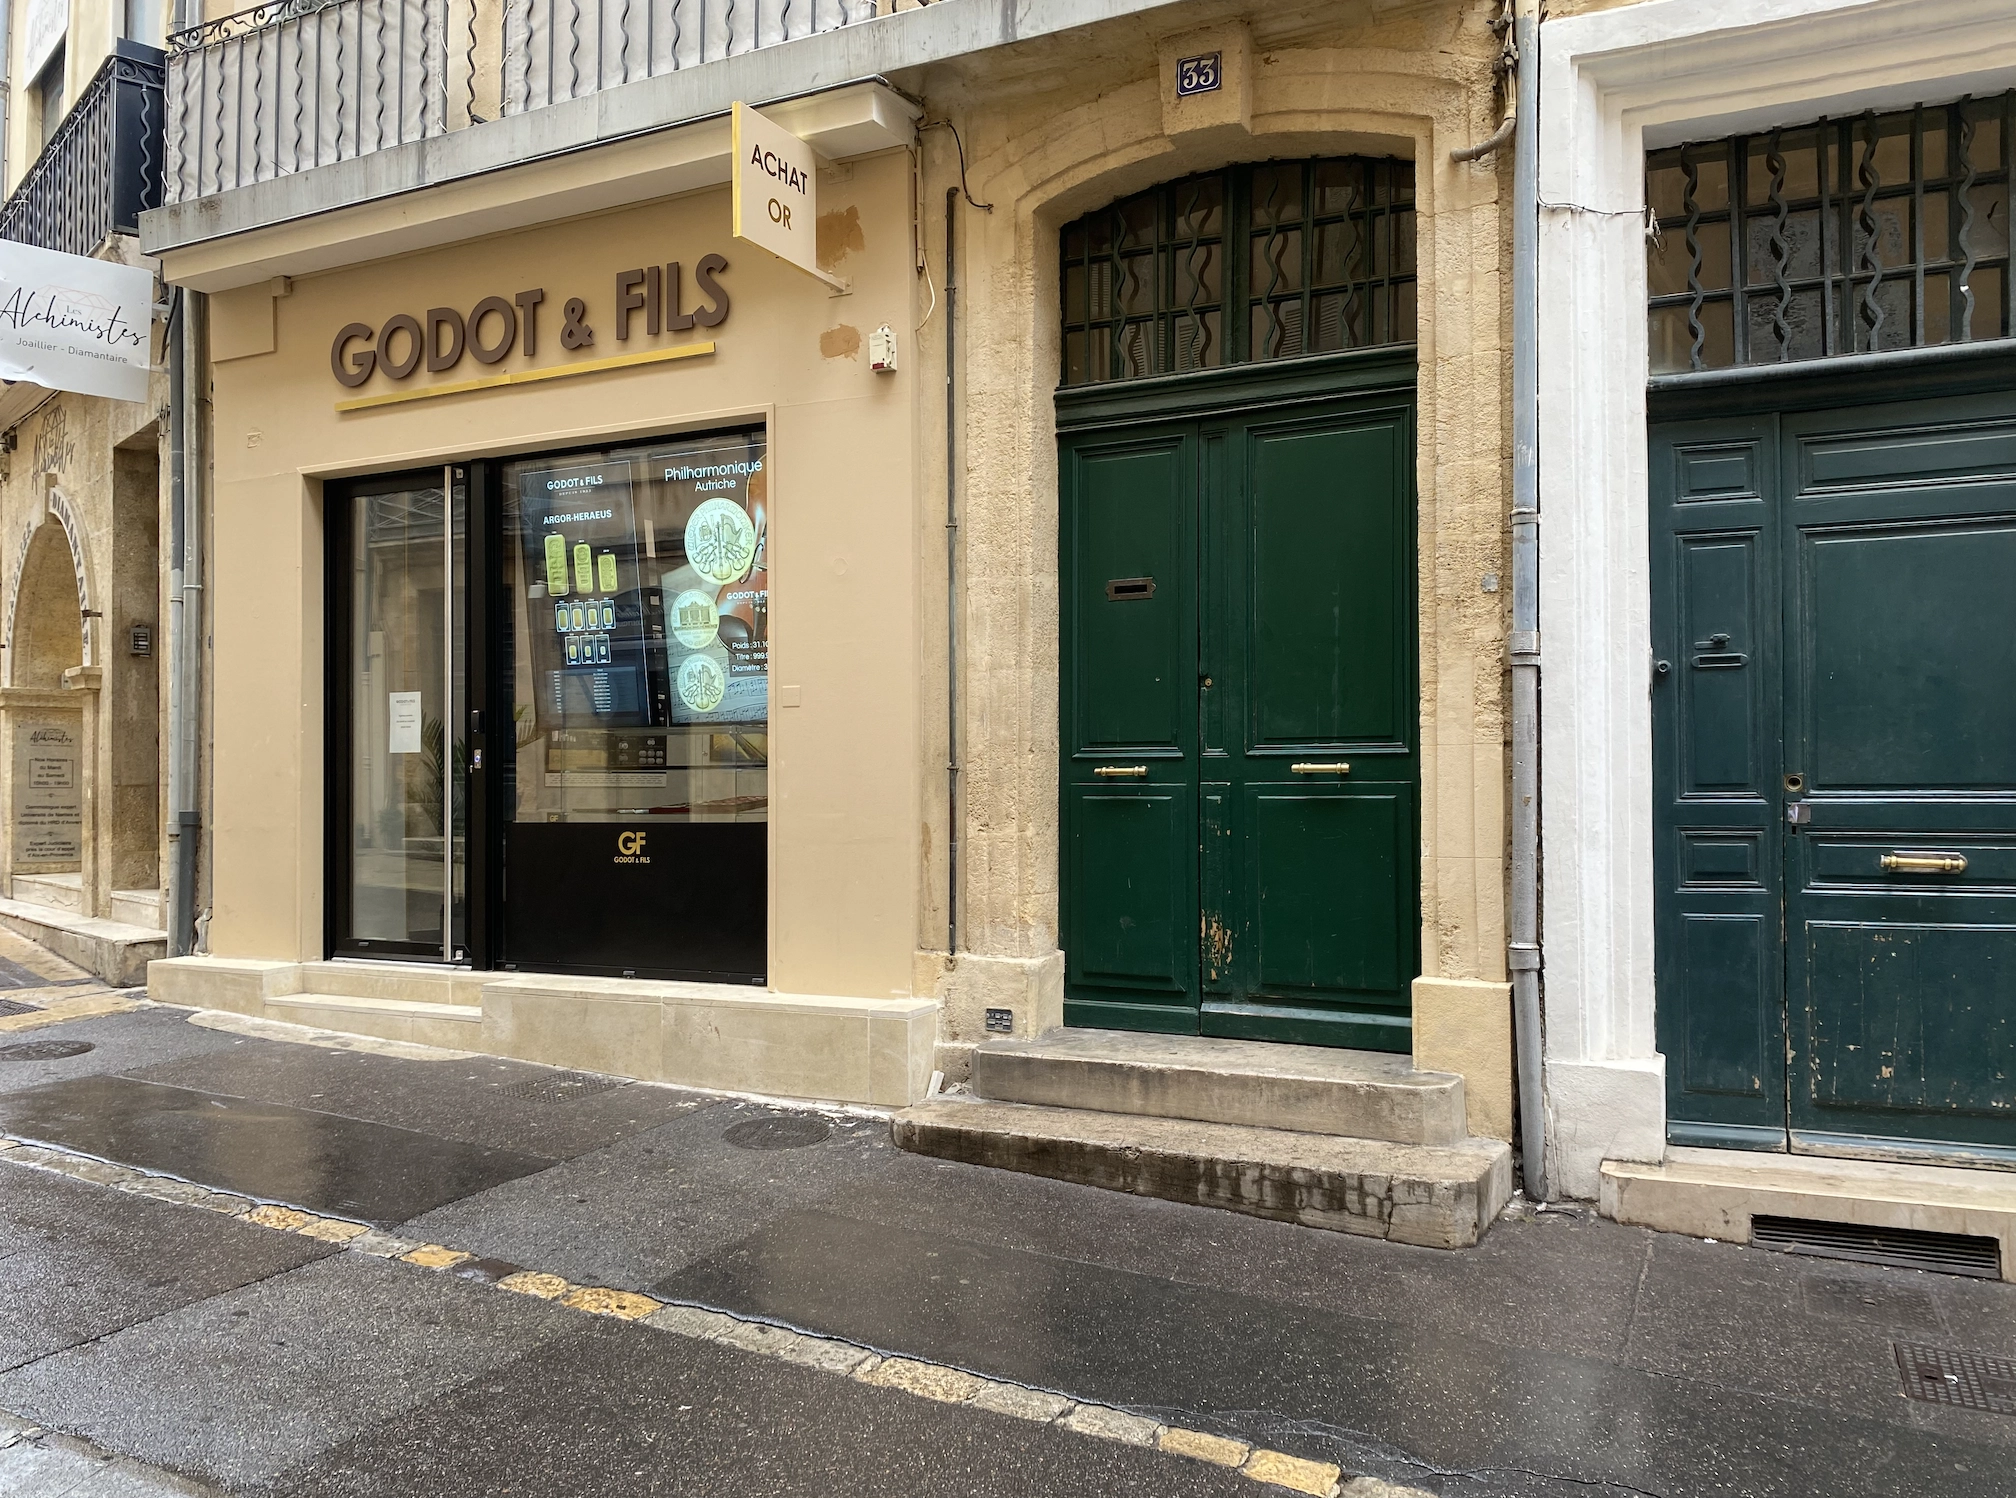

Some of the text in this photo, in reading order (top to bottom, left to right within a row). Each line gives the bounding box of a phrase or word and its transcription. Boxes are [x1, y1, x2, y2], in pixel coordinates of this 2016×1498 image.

[1183, 58, 1215, 89] 33
[751, 143, 808, 196] ACHAT
[767, 197, 792, 231] OR
[0, 286, 147, 346] Alchimistes
[66, 305, 82, 315] Les
[331, 253, 730, 388] GODOT & FILS
[16, 337, 58, 351] Joaillier
[68, 346, 128, 364] Diamantaire
[664, 460, 763, 482] Philharmonique
[546, 477, 579, 490] GODOT
[585, 475, 603, 486] FILS
[694, 478, 737, 492] Autriche
[543, 509, 612, 525] ARGOR-HERAEUS
[726, 591, 754, 600] GODOT
[732, 663, 760, 672] Diamètre
[618, 831, 646, 855] GF
[613, 856, 635, 864] GODOT
[640, 856, 650, 864] FILS
